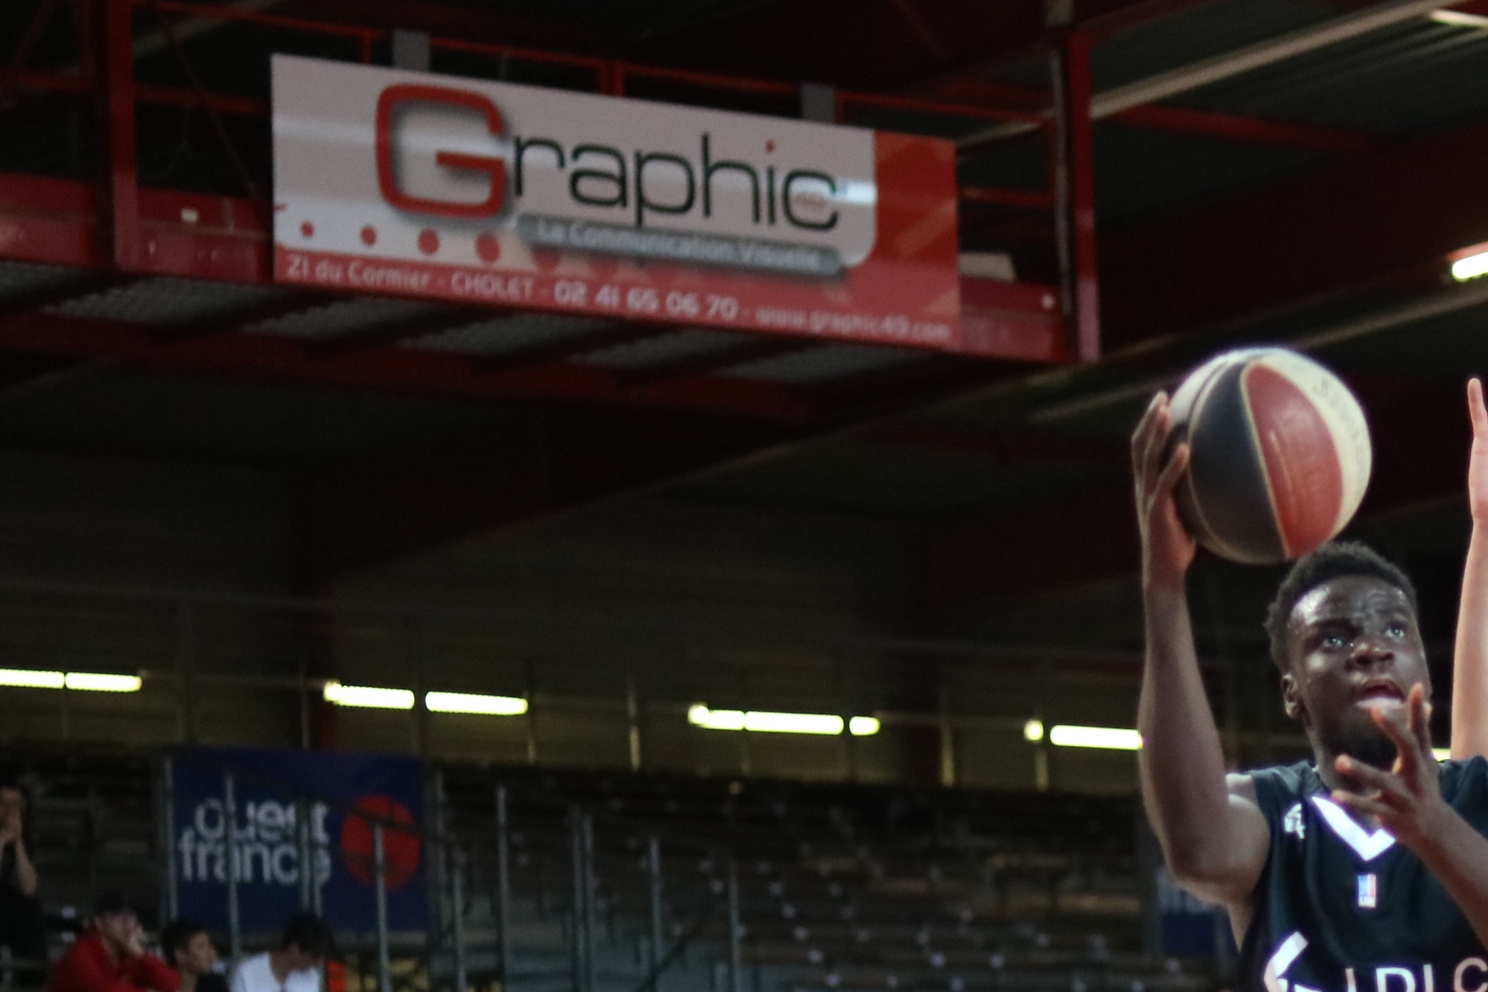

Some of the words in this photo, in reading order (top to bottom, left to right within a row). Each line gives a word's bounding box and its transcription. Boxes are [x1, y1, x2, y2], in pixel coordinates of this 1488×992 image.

[375, 83, 838, 231] Graphic
[315, 256, 343, 282] du
[451, 273, 534, 300] CHOLET
[554, 279, 588, 305] 02
[595, 284, 620, 309] 41
[626, 287, 658, 314] 65
[665, 291, 699, 317] 06
[705, 294, 739, 321] 70
